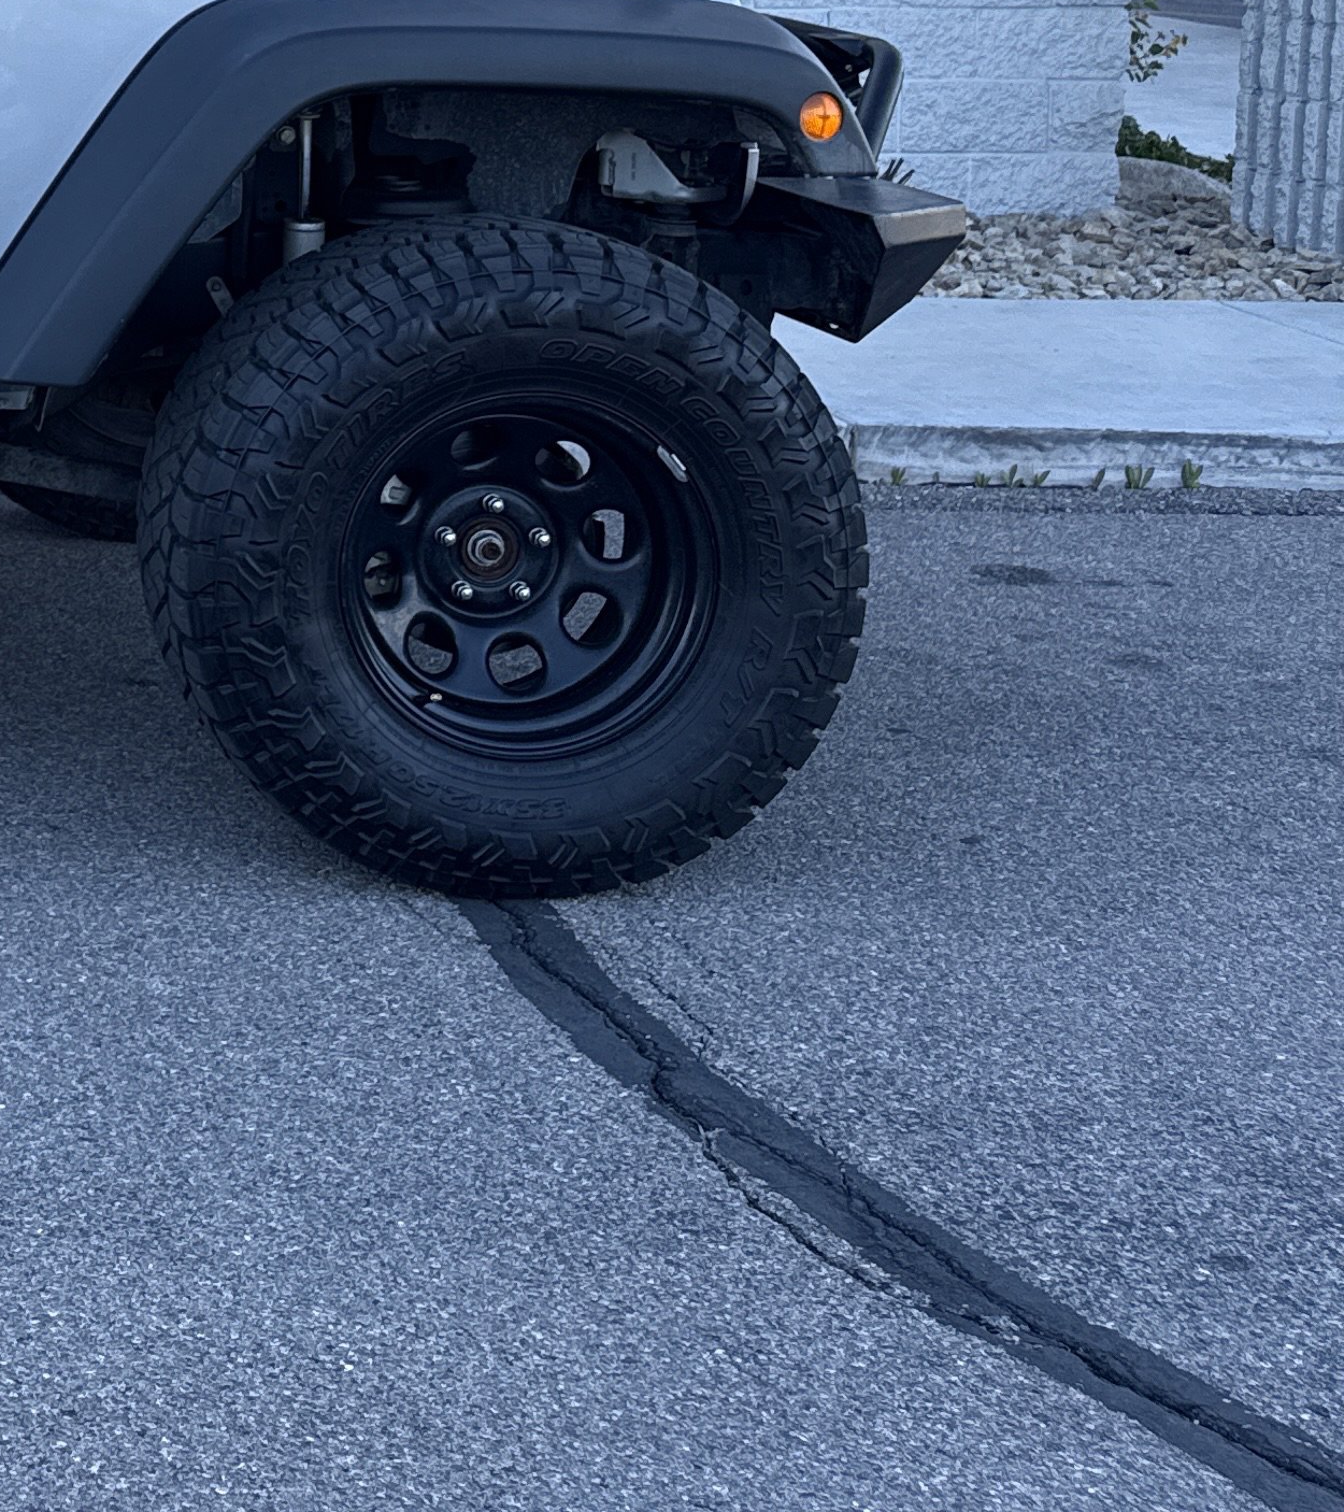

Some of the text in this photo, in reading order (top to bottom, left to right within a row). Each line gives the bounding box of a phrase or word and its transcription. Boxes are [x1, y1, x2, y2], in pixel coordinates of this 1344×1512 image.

[322, 348, 469, 470] TIRES
[539, 338, 785, 730] OPEN COUNTRY R/T
